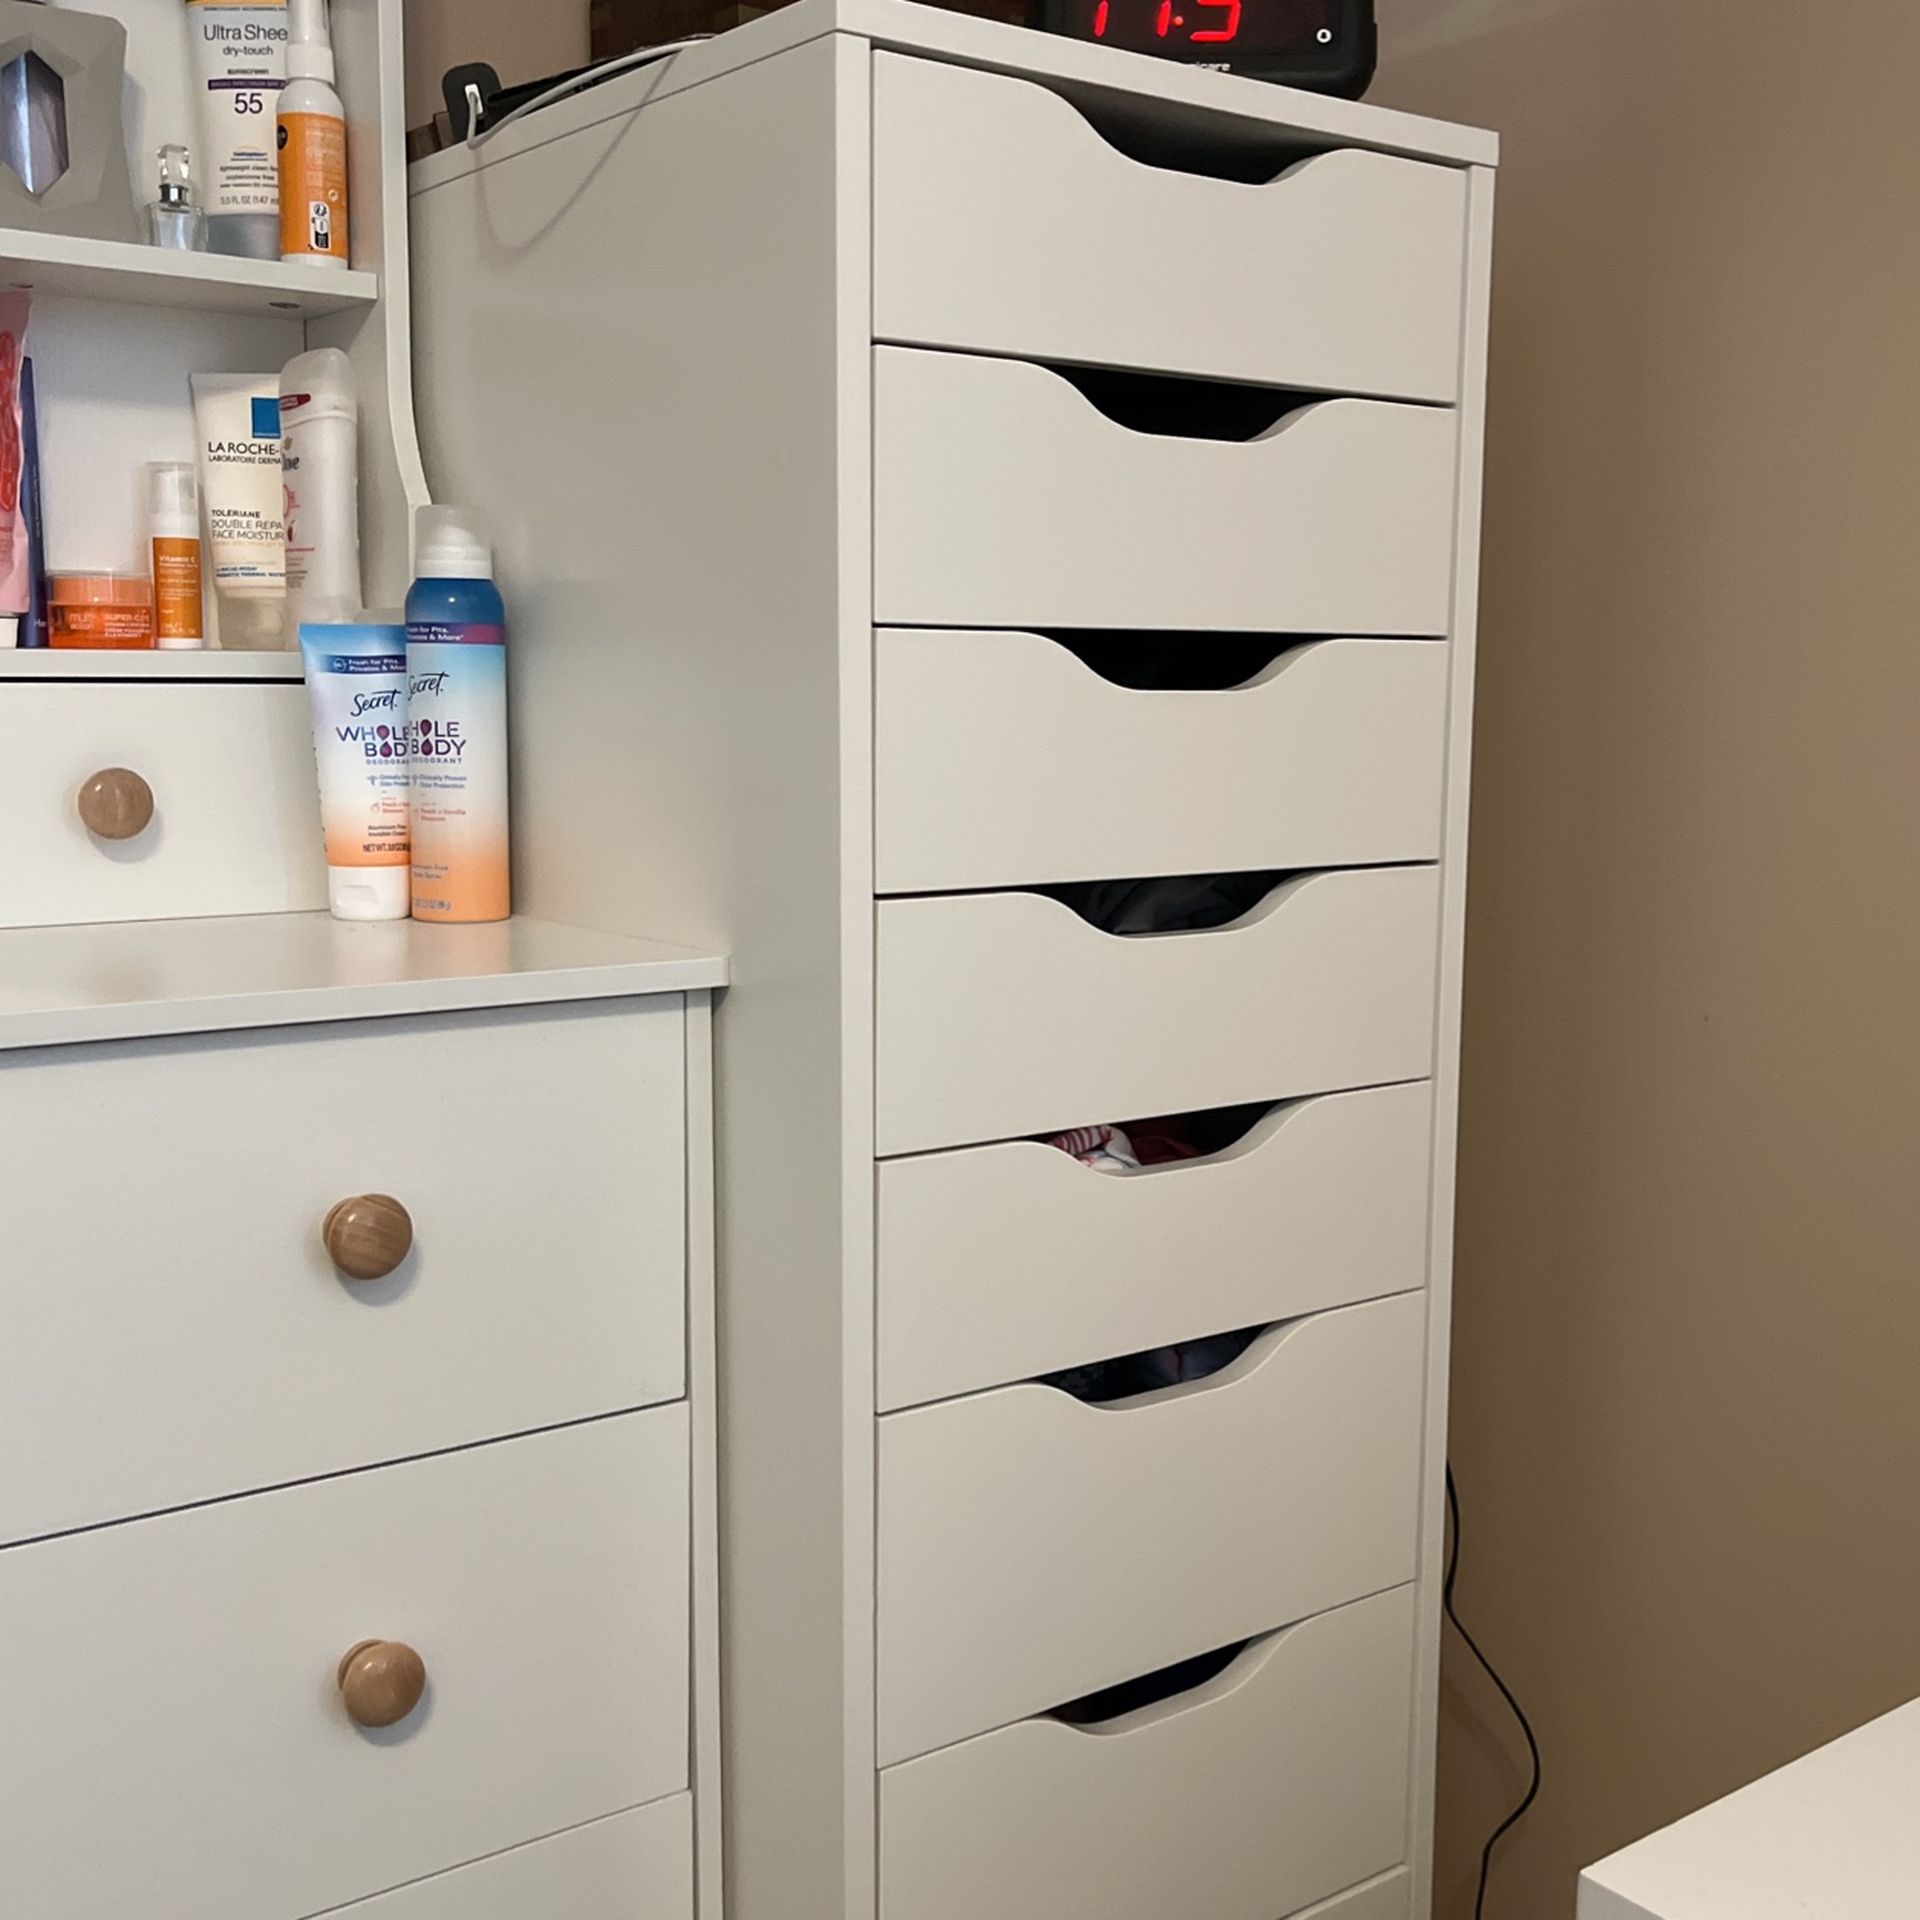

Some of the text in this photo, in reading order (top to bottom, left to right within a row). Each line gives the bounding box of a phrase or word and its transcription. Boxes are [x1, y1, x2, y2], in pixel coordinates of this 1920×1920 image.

[203, 24, 242, 41] Ultra
[222, 45, 274, 57] dry-touch
[234, 92, 263, 115] 55
[208, 442, 280, 455] LA ROCHE-
[211, 509, 261, 519] TOLERIANE
[211, 518, 253, 530] DOUBLE
[212, 530, 235, 540] FACE
[350, 688, 402, 717] Secret
[364, 741, 408, 758] BOD
[411, 738, 467, 757] BODY
